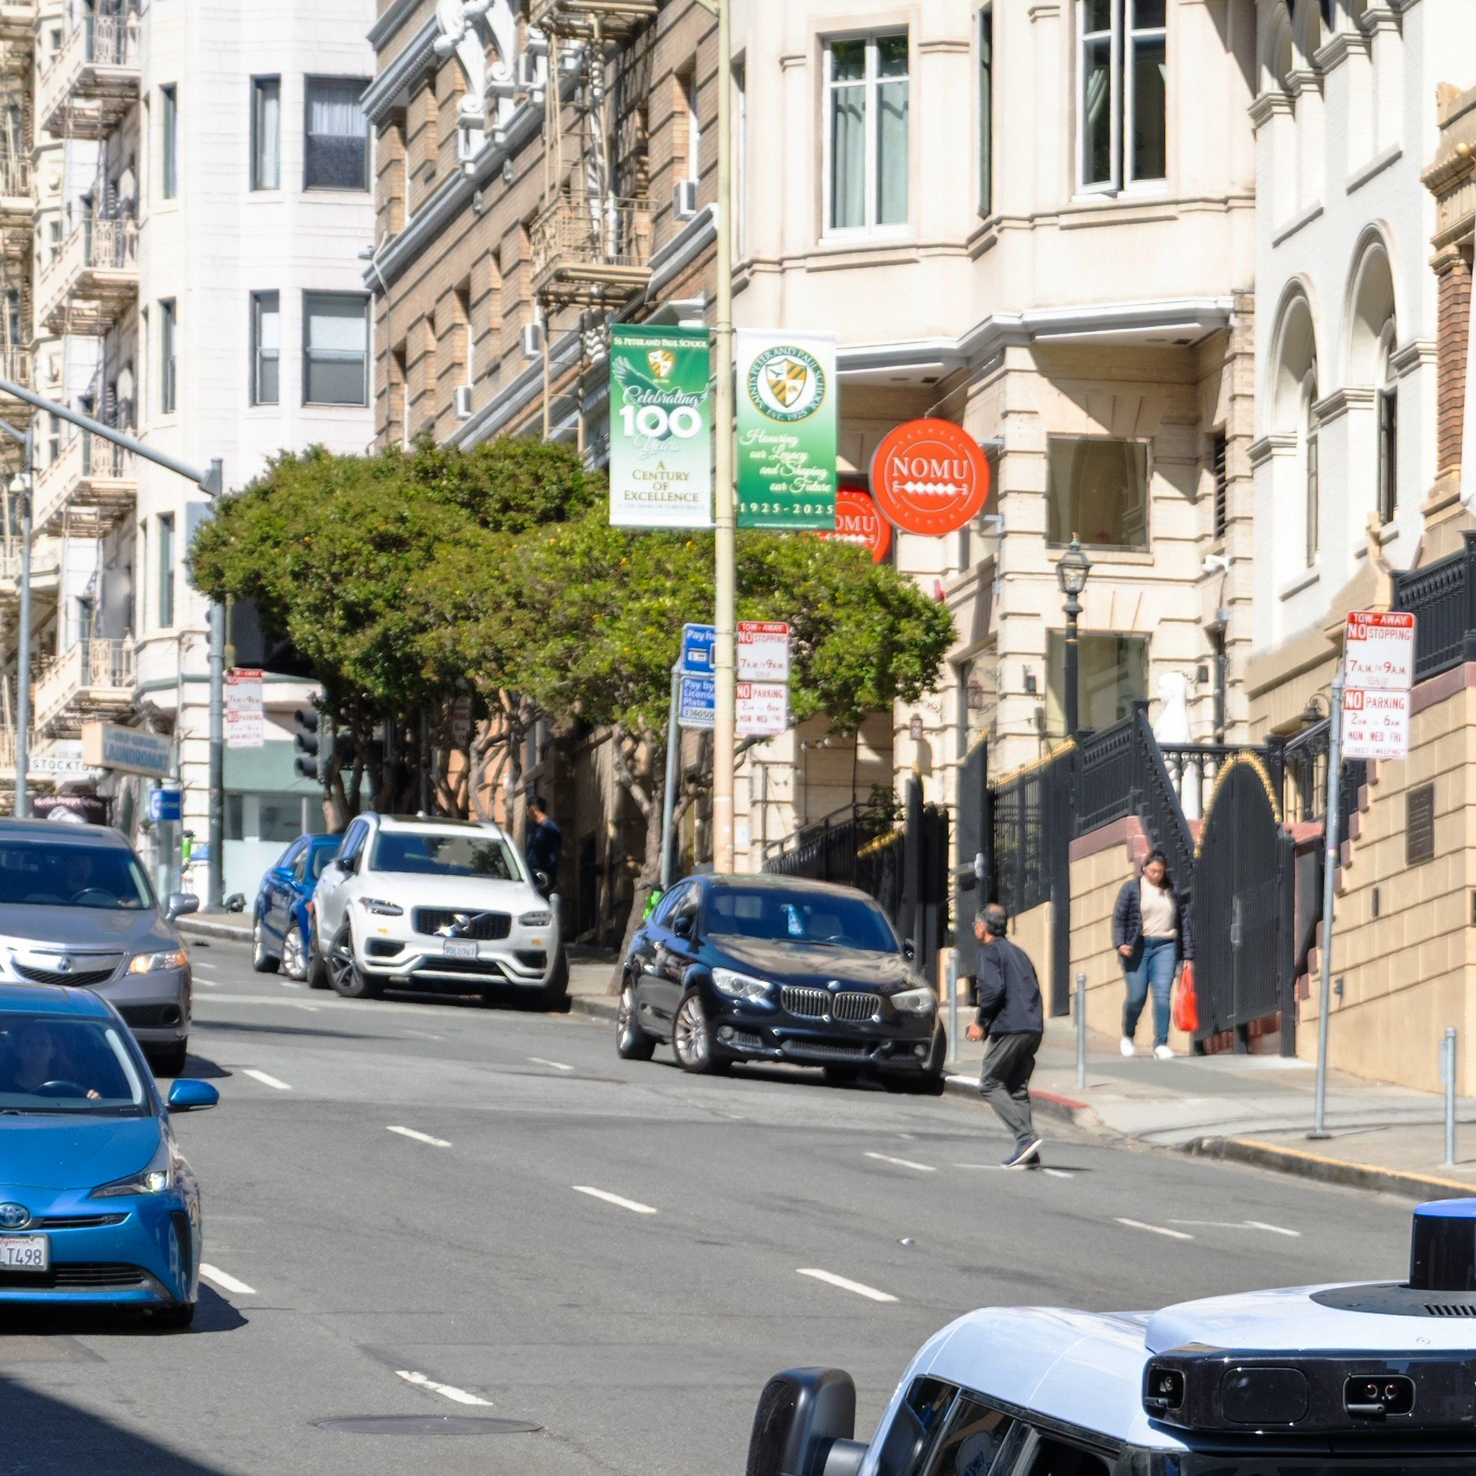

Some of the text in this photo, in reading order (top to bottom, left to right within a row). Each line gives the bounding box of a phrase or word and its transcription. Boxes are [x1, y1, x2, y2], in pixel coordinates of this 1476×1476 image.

[622, 384, 702, 410] Celebrating
[618, 404, 702, 439] 100
[739, 427, 799, 449] Honoring
[749, 442, 808, 465] our Legacy
[759, 460, 828, 481] and Shaping
[892, 456, 969, 480] NOMU
[769, 476, 832, 494] our Future
[835, 513, 875, 532] OMU
[738, 631, 754, 644] NO
[1347, 624, 1410, 641] NO STOPPING
[684, 679, 701, 691] Pay
[736, 684, 784, 699] NO PARKING
[1345, 690, 1405, 710] NO PARKING
[1348, 730, 1402, 743] MON WED FRI
